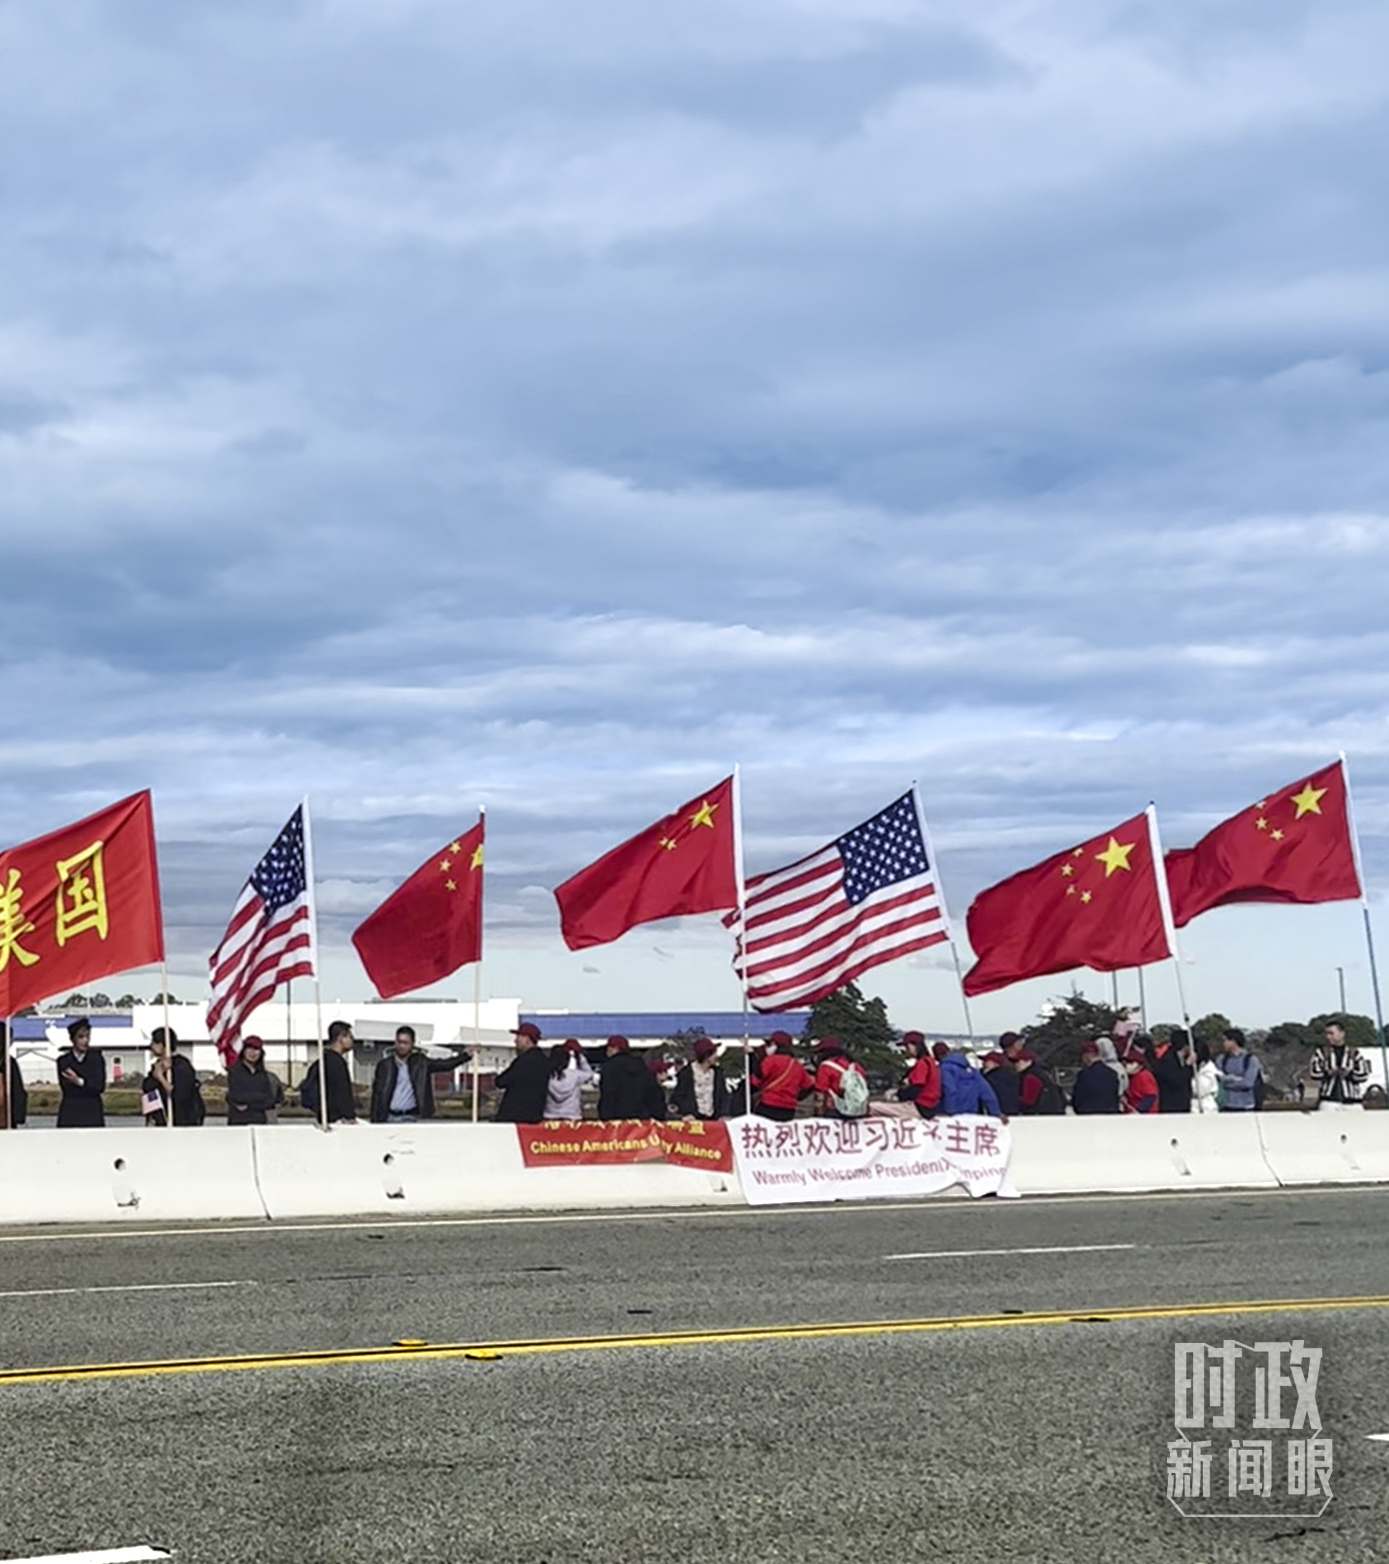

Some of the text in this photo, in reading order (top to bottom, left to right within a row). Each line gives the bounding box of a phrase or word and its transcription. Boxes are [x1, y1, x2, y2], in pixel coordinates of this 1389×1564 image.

[530, 1140, 580, 1154] Chinese
[582, 1138, 648, 1152] Americans
[674, 1141, 722, 1160] Alliance
[751, 1169, 807, 1186] Warmly
[807, 1167, 873, 1182] Welcome
